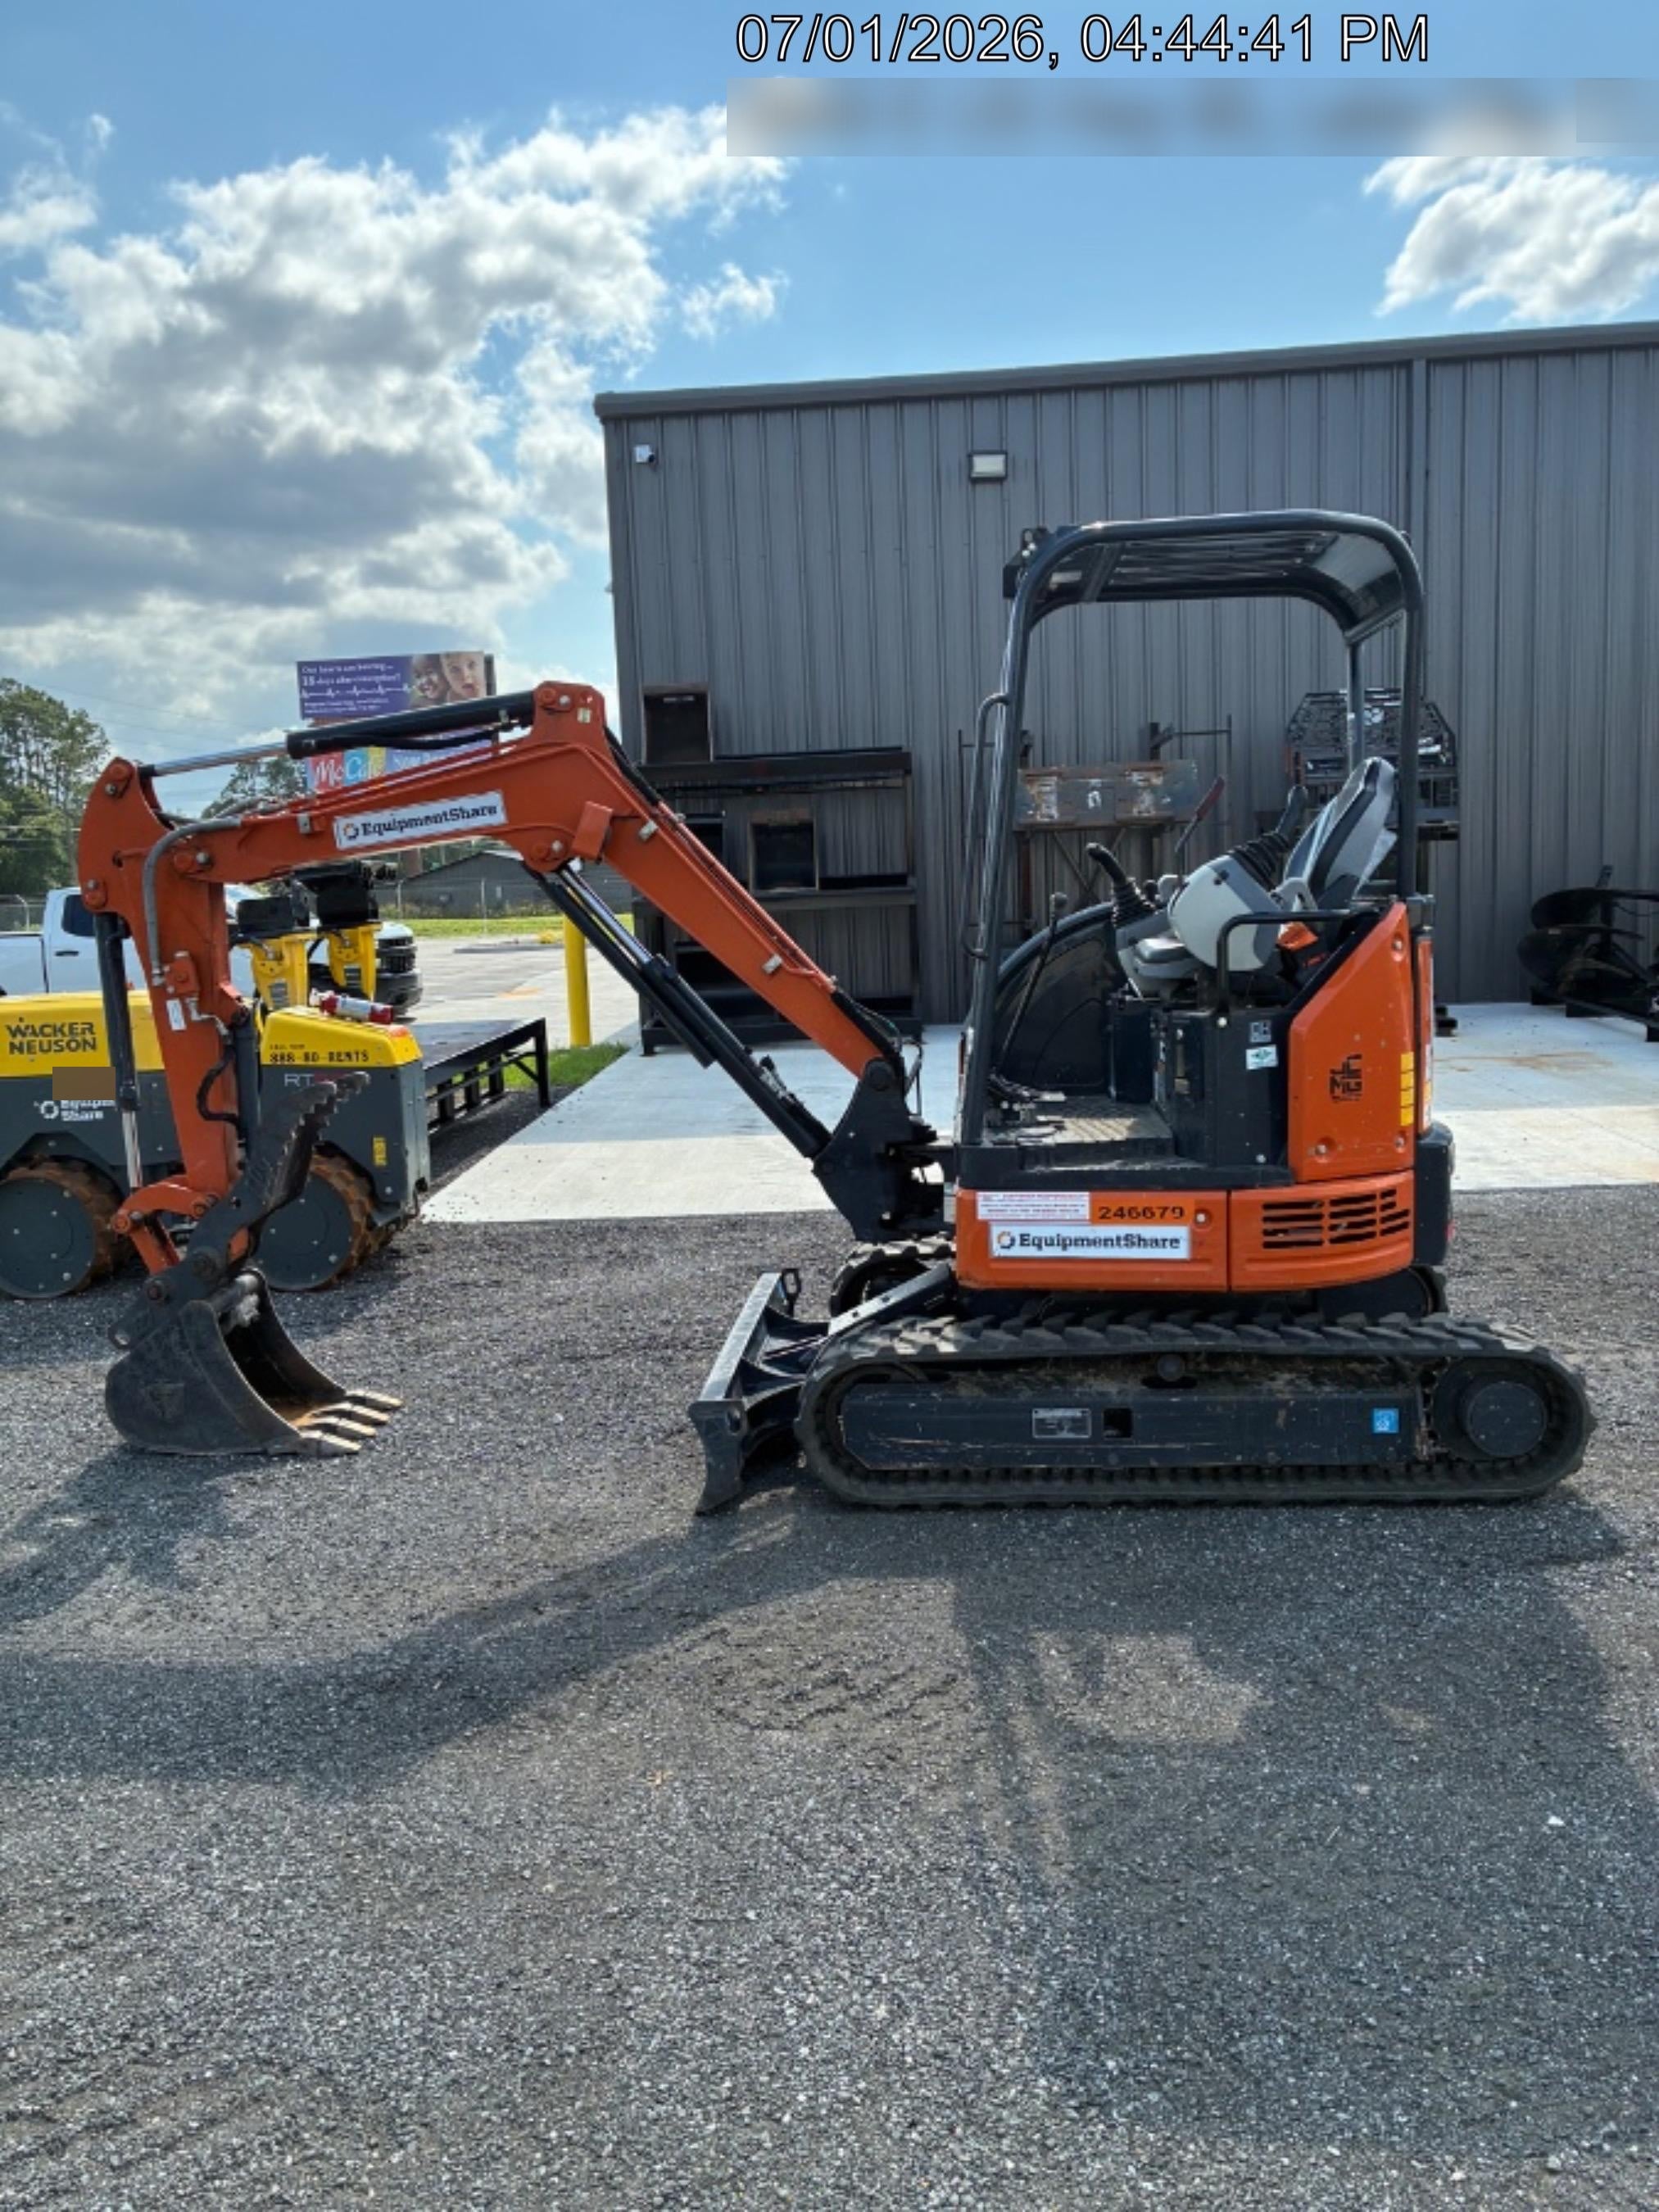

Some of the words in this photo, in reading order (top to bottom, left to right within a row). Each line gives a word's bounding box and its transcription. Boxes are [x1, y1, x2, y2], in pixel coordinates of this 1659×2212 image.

[360, 804, 497, 836] EquipmentShare
[6, 1022, 96, 1038] WACKER
[9, 1037, 97, 1055] NEUSON
[1099, 1205, 1185, 1220] 246679
[1018, 1232, 1181, 1252] EquipmentShare
